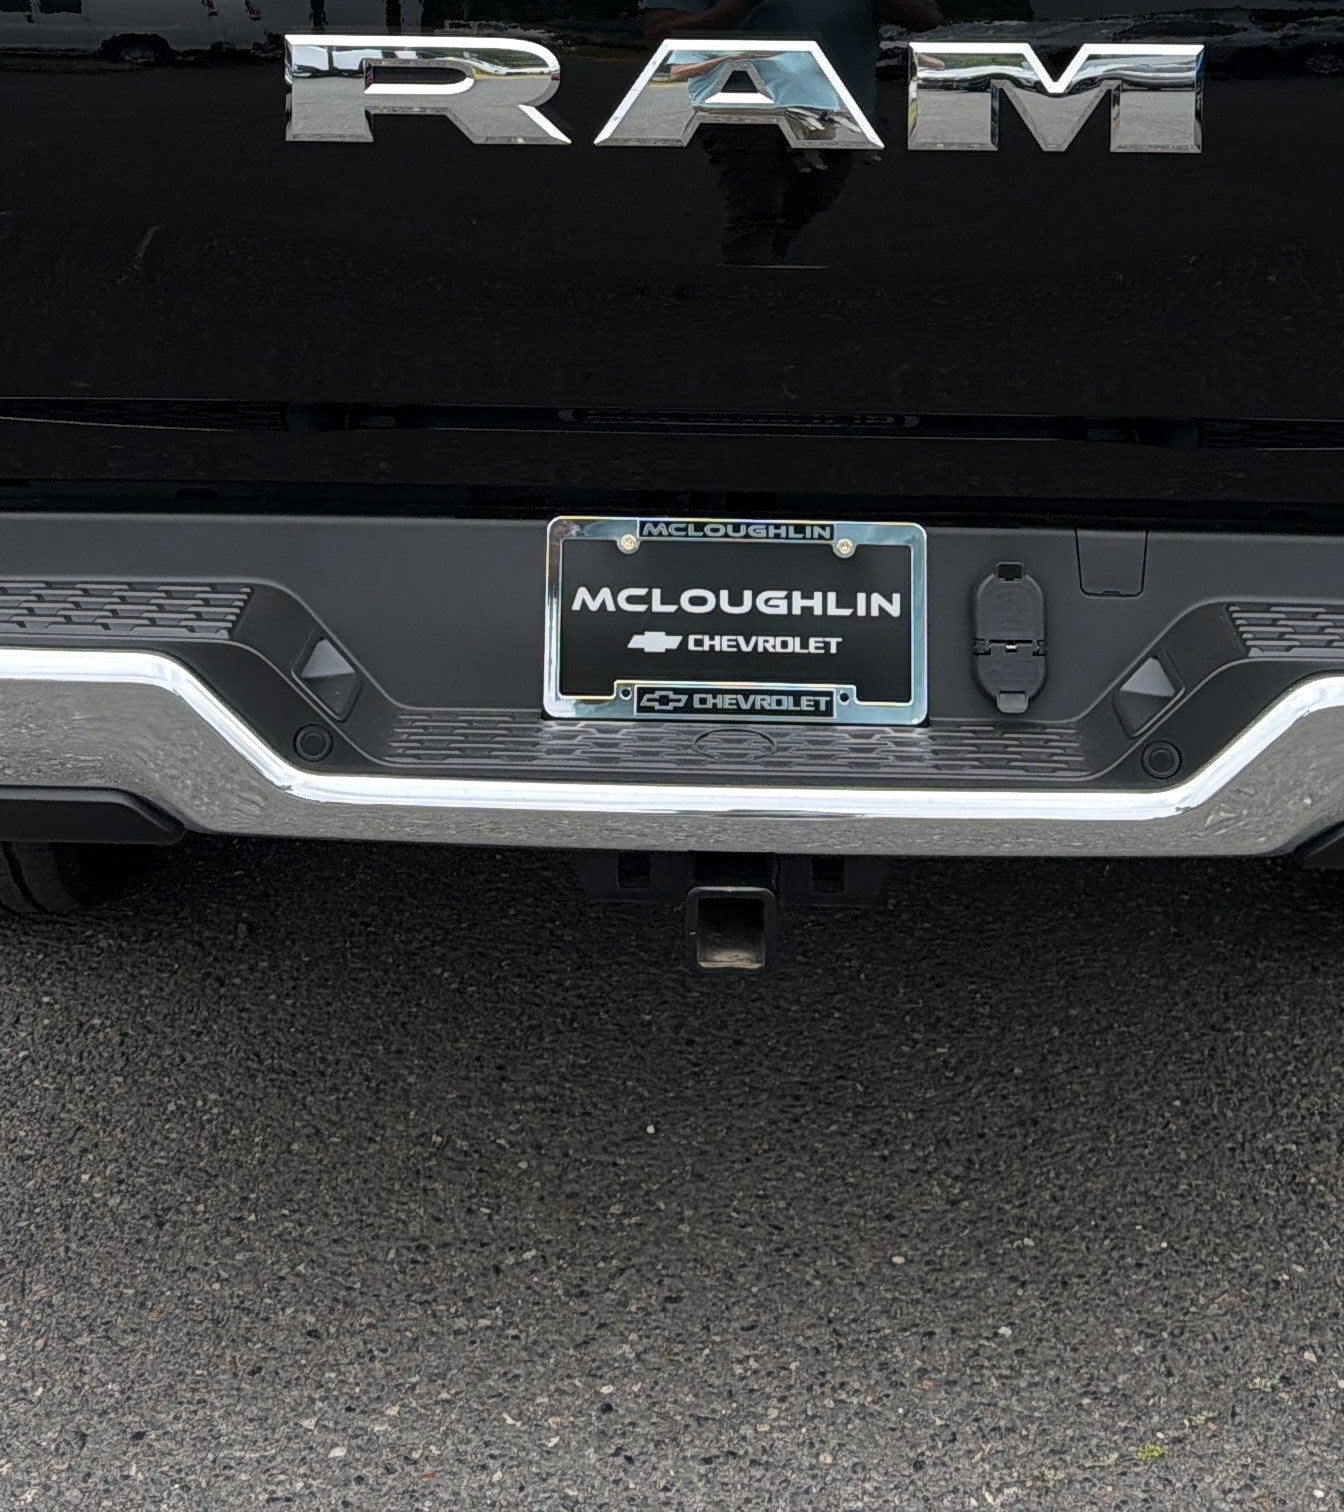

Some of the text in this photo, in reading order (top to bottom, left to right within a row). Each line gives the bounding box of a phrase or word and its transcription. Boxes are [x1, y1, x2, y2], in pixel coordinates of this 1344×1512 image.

[284, 34, 1205, 152] RAM
[642, 522, 831, 539] MCLOUGHLIN
[571, 586, 901, 618] MCLOUGHLIN
[687, 634, 843, 654] CHEVROLET
[692, 693, 830, 711] CHEVROLET
